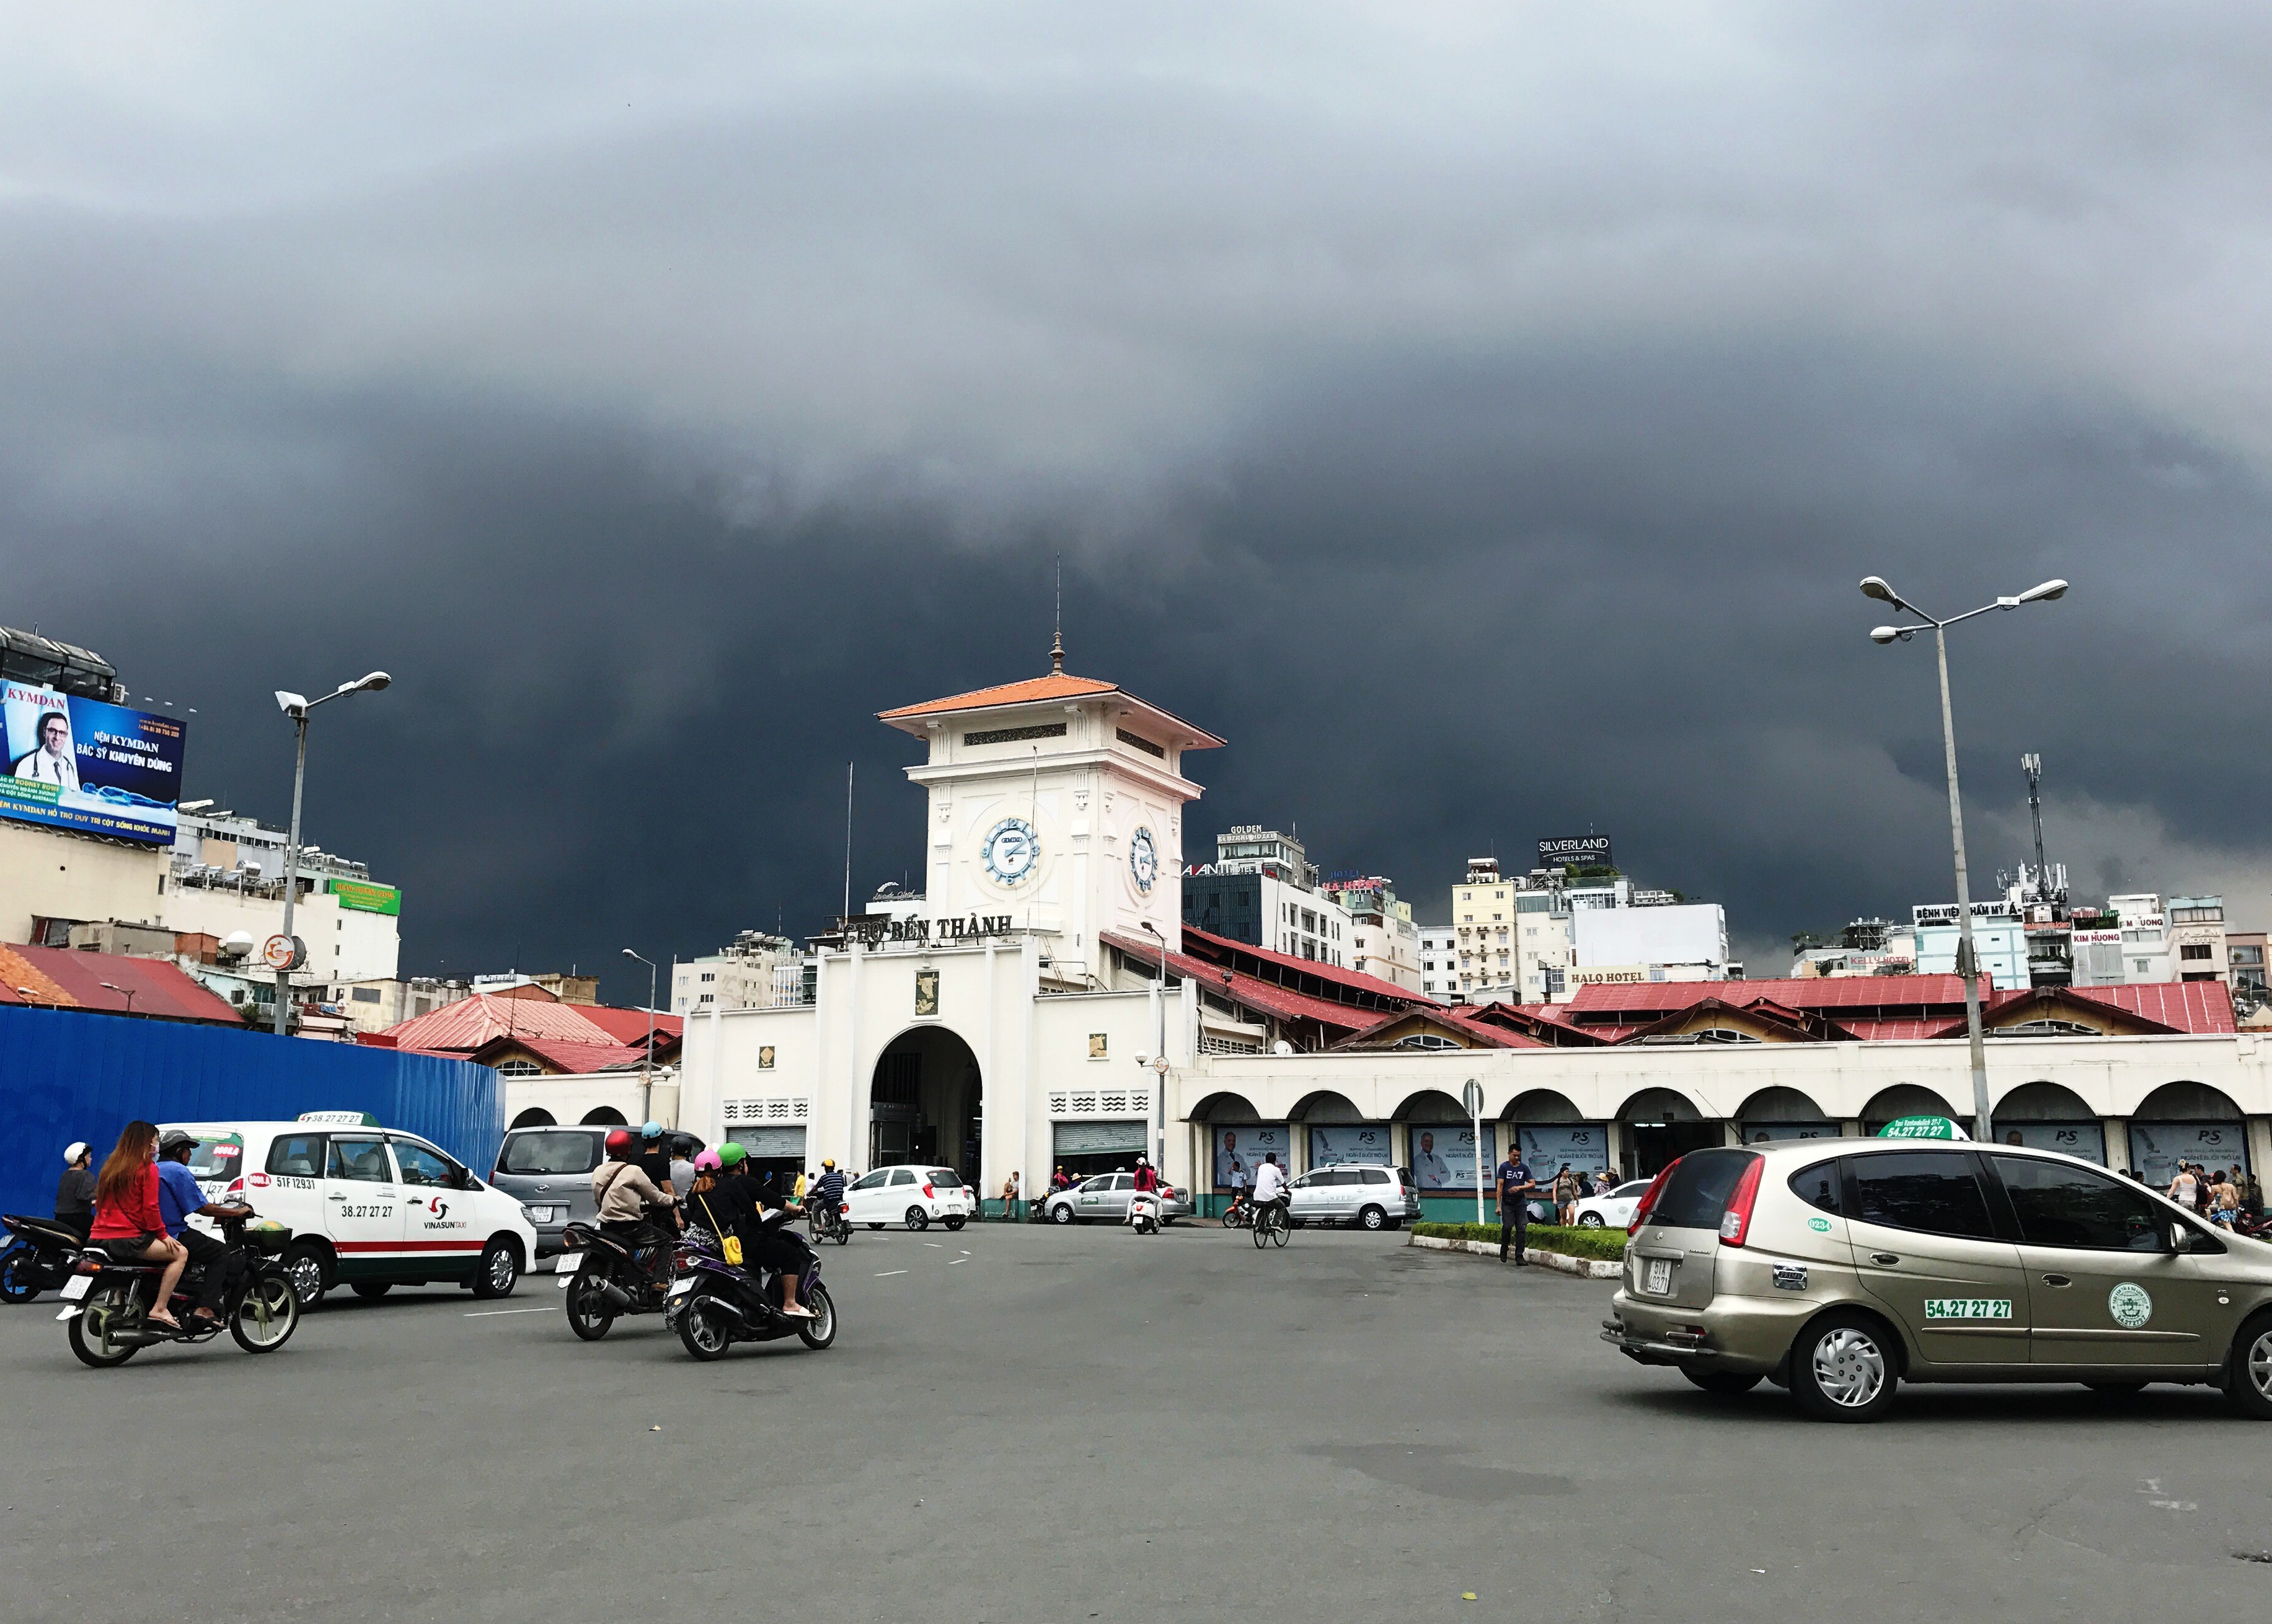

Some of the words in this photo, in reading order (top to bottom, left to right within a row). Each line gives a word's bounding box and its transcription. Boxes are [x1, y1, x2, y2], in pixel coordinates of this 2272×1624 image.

[8, 687, 65, 710] KYMDAN
[94, 730, 110, 744] NỆM
[112, 735, 159, 753] KYMDAN
[76, 743, 94, 756] BÁC
[109, 750, 146, 767] KHUYÊN
[13, 803, 46, 815] KYMDAN
[1231, 824, 1262, 834] GOLDEN
[1539, 838, 1609, 852] SILVERLAND
[1182, 863, 1229, 875] AVANTI
[1917, 907, 1940, 919] BỆNH
[1969, 904, 1989, 916] HẨM
[890, 914, 930, 940] BẾN
[937, 912, 1012, 938] THÀNH
[1571, 973, 1603, 982] HALO
[1606, 973, 1644, 982] HOTEL
[337, 1114, 348, 1123] 27
[348, 1114, 360, 1123] 27
[1887, 1127, 1914, 1137] 54.27
[1915, 1126, 1929, 1136] 27
[1929, 1126, 1944, 1136] 27
[1506, 1170, 1524, 1180] EA7
[276, 1177, 291, 1188] 51F
[211, 1185, 223, 1194] 27
[342, 1206, 367, 1217] 38.27
[369, 1206, 380, 1217] 27
[382, 1206, 393, 1217] 27
[1809, 1219, 1831, 1230] 0234
[1654, 1260, 1666, 1276] 51A
[1927, 1300, 1967, 1317] 54.27
[1972, 1300, 1989, 1317] 27
[1993, 1300, 2010, 1317] 27
